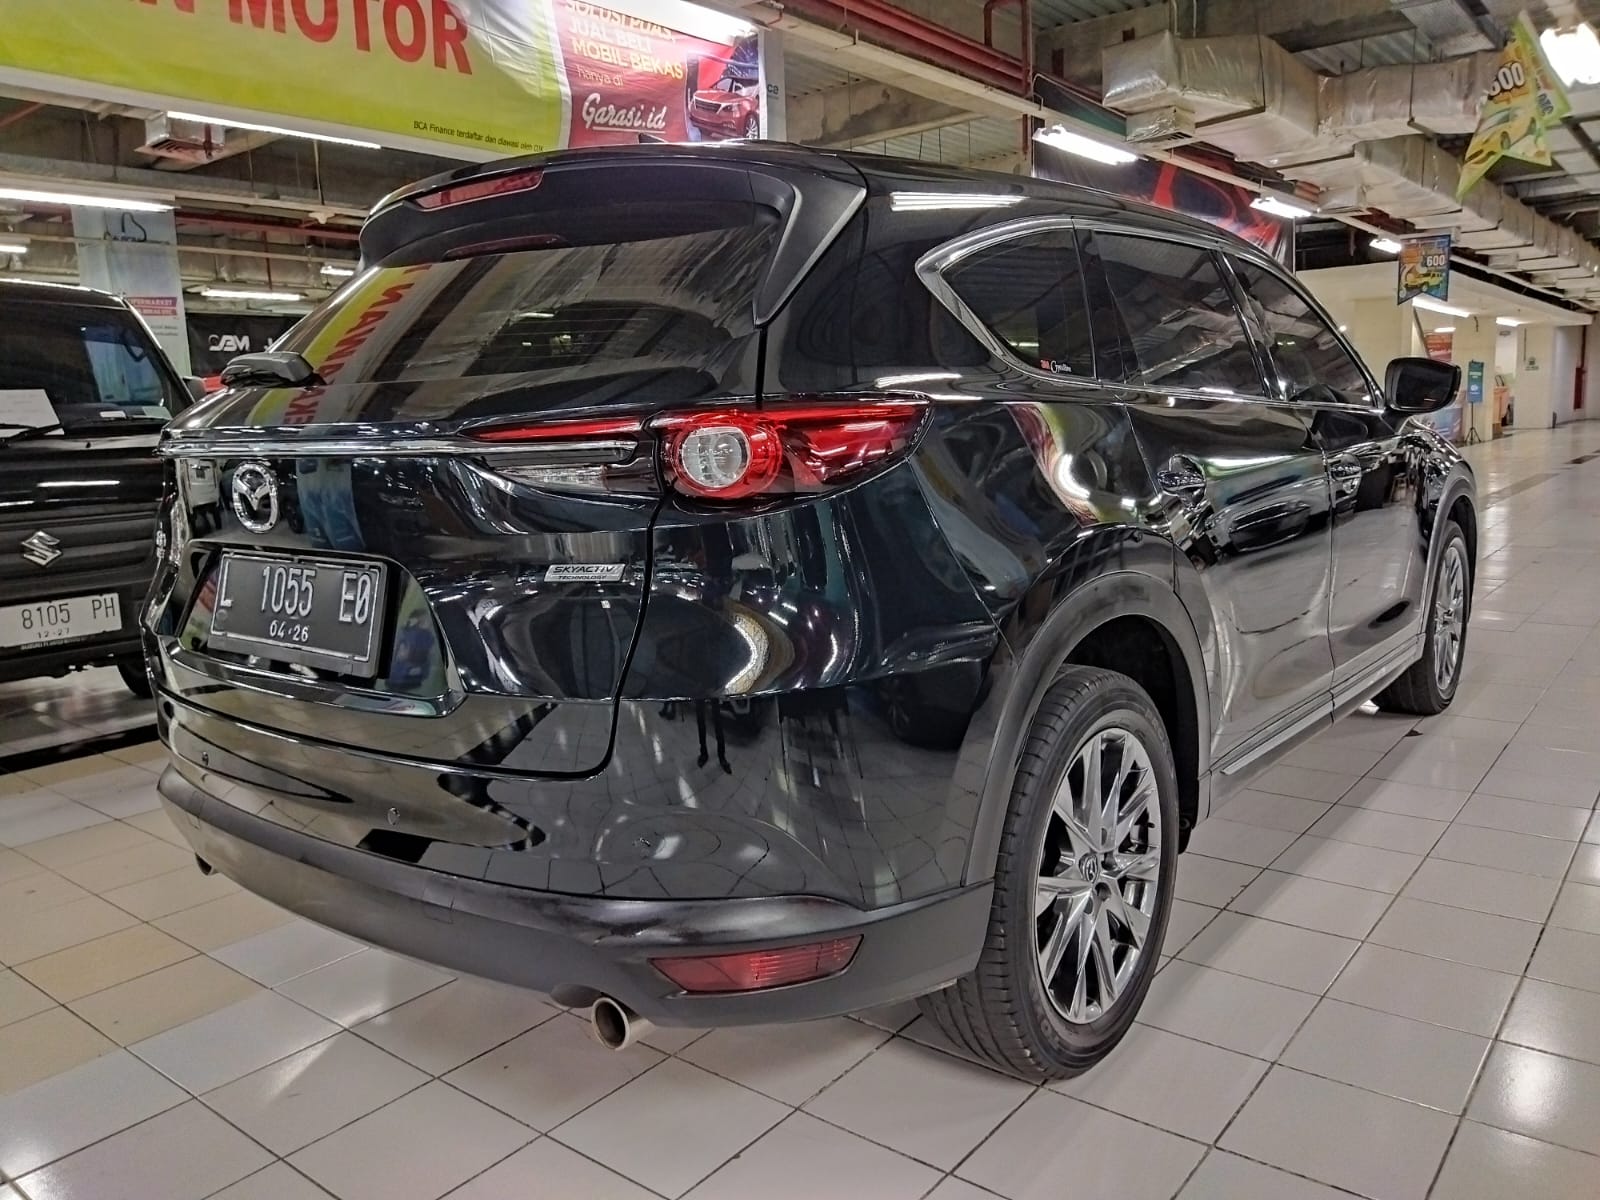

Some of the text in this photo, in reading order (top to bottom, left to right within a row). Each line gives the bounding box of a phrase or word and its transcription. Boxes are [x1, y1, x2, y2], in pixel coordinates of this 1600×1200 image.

[571, 38, 684, 79] MOBIL BEKAS
[582, 92, 667, 129] Garasi.id
[413, 120, 428, 130] BCA
[429, 124, 455, 137] Finance
[1426, 254, 1446, 267] 600
[552, 566, 616, 574] SKYACTIV
[220, 558, 233, 608] L
[261, 565, 317, 617] 1055
[21, 596, 116, 630] 8105 PH
